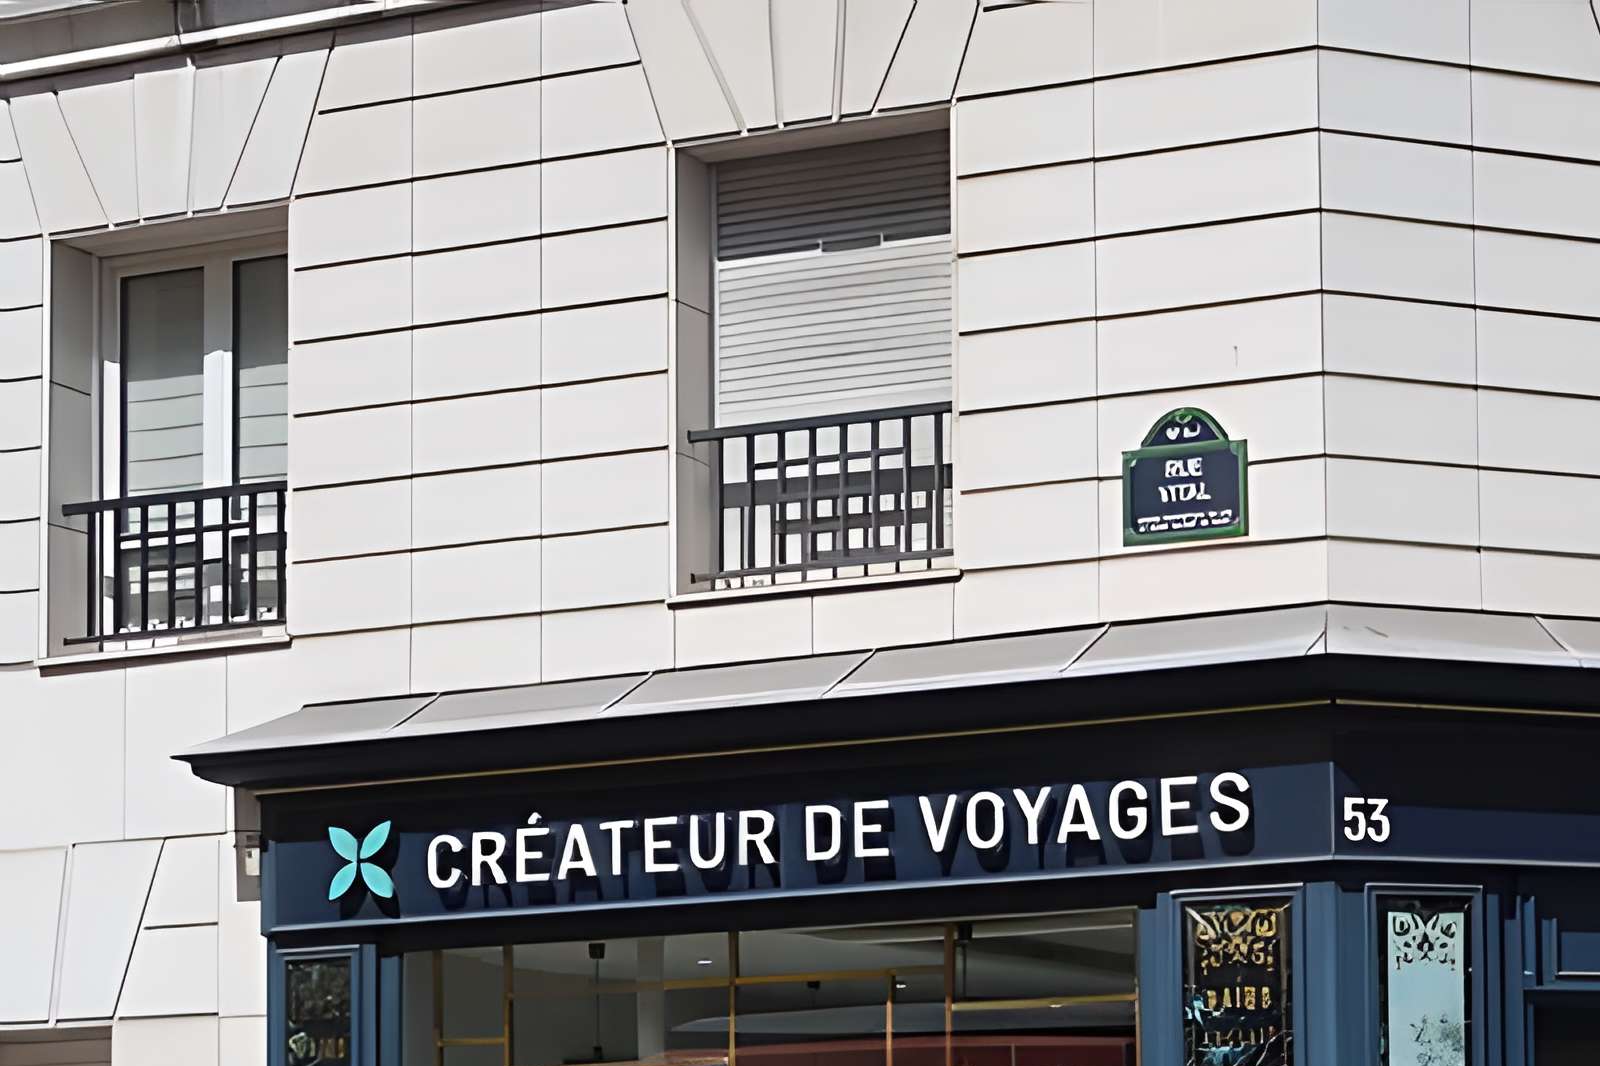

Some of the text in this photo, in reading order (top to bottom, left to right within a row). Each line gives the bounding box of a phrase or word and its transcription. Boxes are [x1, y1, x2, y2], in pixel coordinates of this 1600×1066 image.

[427, 771, 1250, 889] CRÉATEUR DE VOYAGES
[1343, 796, 1391, 843] 53
